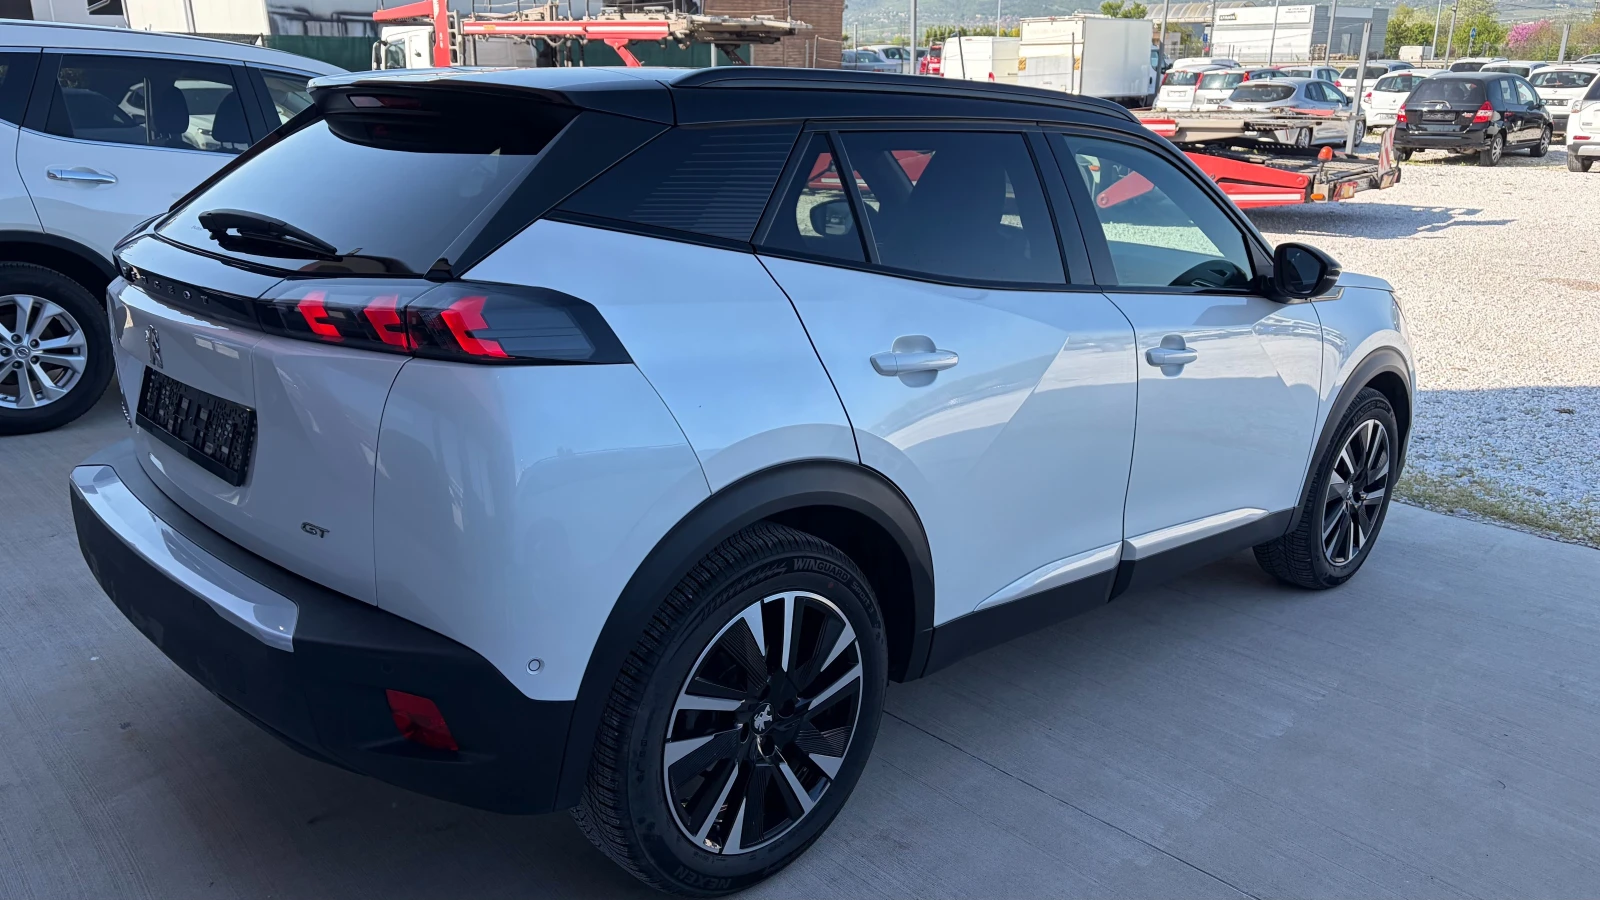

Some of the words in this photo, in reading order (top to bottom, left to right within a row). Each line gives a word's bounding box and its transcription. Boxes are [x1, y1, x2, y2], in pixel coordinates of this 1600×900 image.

[301, 521, 330, 539] GT
[793, 559, 850, 582] WINGUARD
[674, 866, 732, 889] NEXEN
